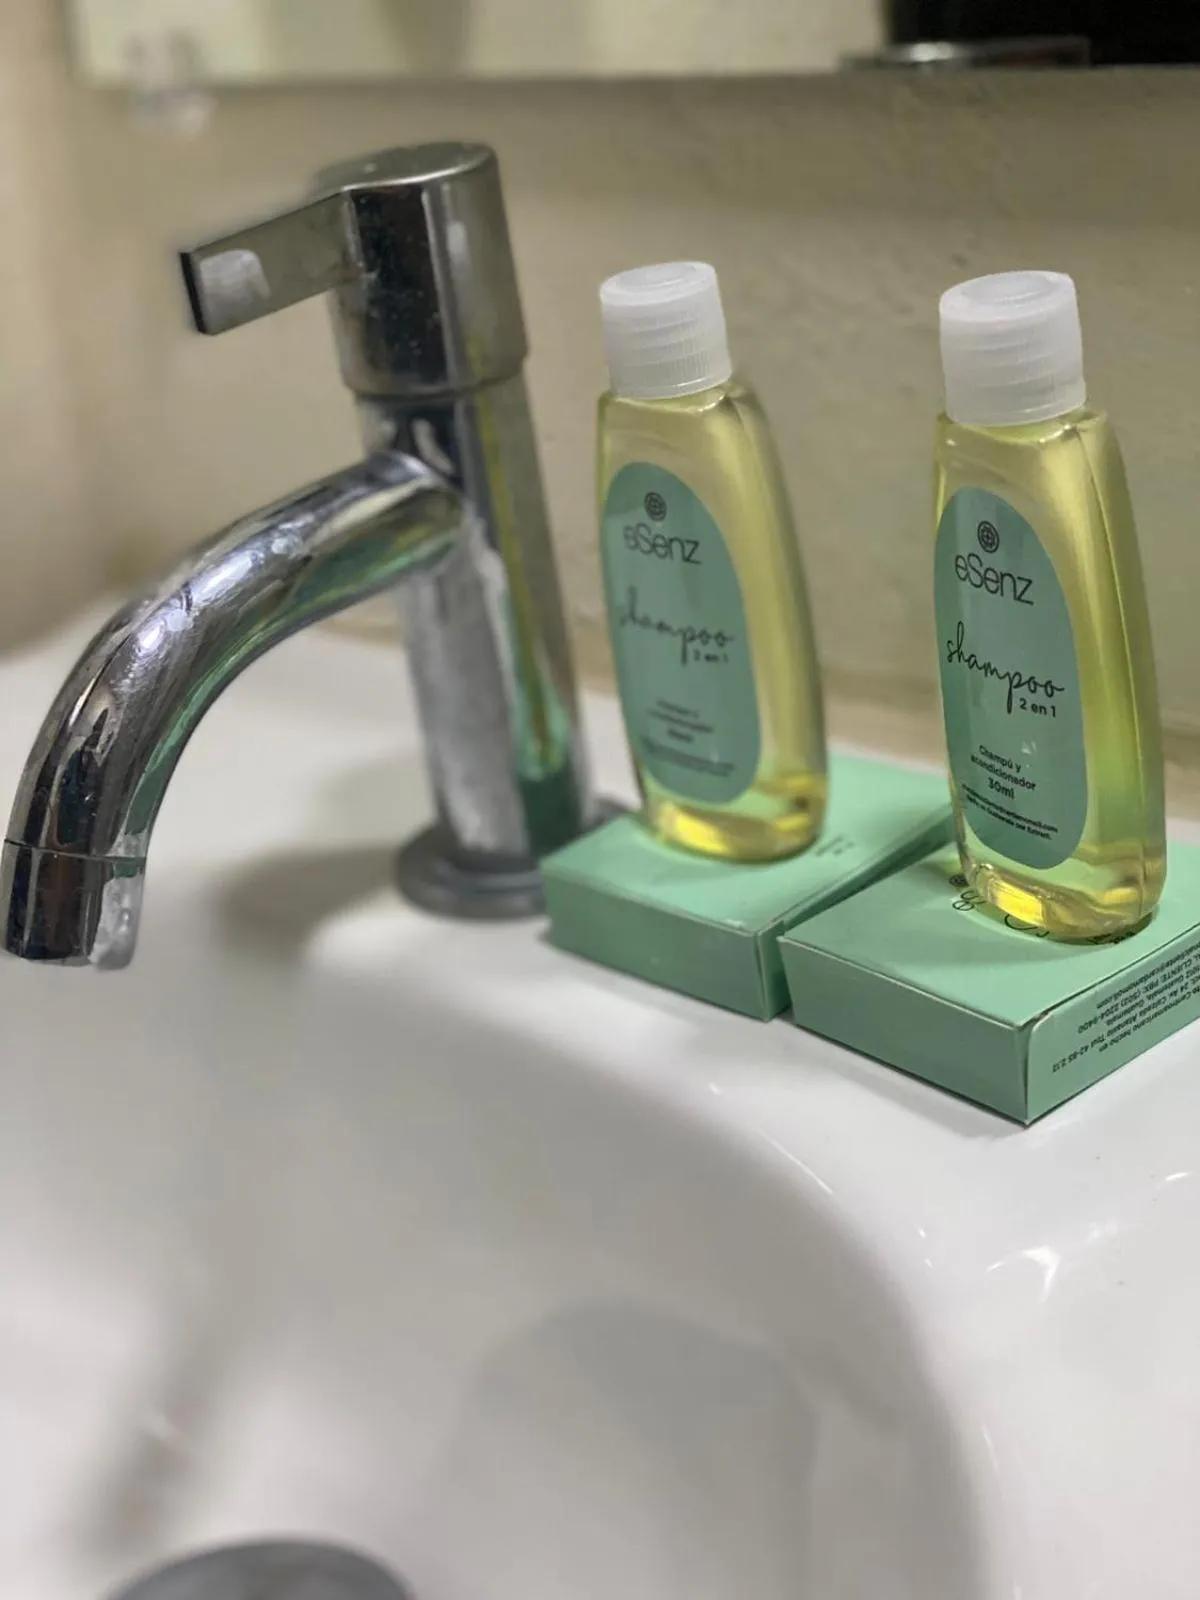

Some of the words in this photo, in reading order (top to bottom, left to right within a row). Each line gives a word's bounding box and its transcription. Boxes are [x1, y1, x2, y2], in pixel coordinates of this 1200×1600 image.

[622, 522, 703, 565] eSenz
[954, 552, 1034, 605] eSenz
[946, 620, 1065, 715] shampoo
[1019, 698, 1028, 710] 2
[1030, 703, 1047, 716] en
[1049, 704, 1056, 718] 1
[978, 743, 1013, 770] Champú
[1014, 762, 1022, 773] y
[987, 776, 1015, 800] 30ml
